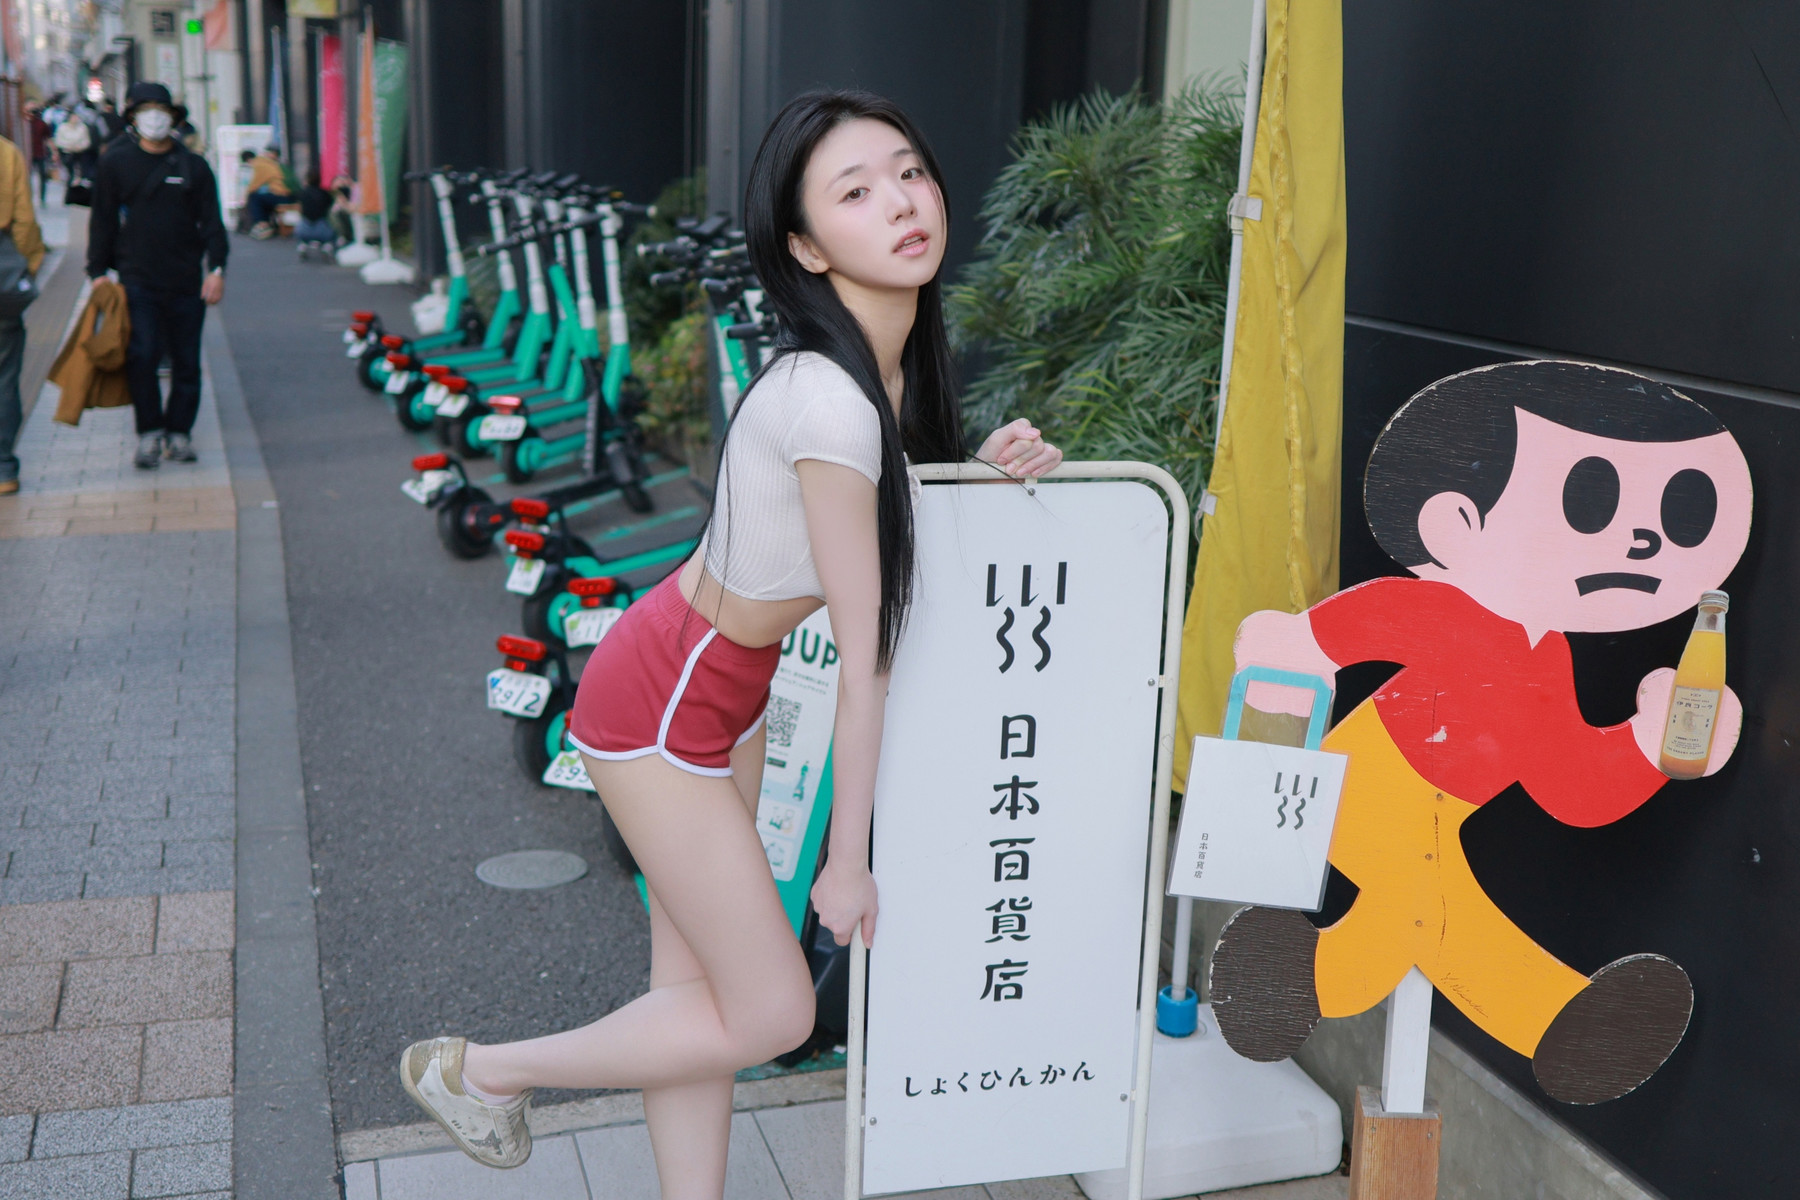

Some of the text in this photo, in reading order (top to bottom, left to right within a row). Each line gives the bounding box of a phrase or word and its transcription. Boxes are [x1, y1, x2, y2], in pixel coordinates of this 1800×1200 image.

[979, 714, 1040, 1002] 日本百貨店
[1194, 832, 1209, 879] 日本百貨店
[905, 1061, 1096, 1098] しょくひんかん
